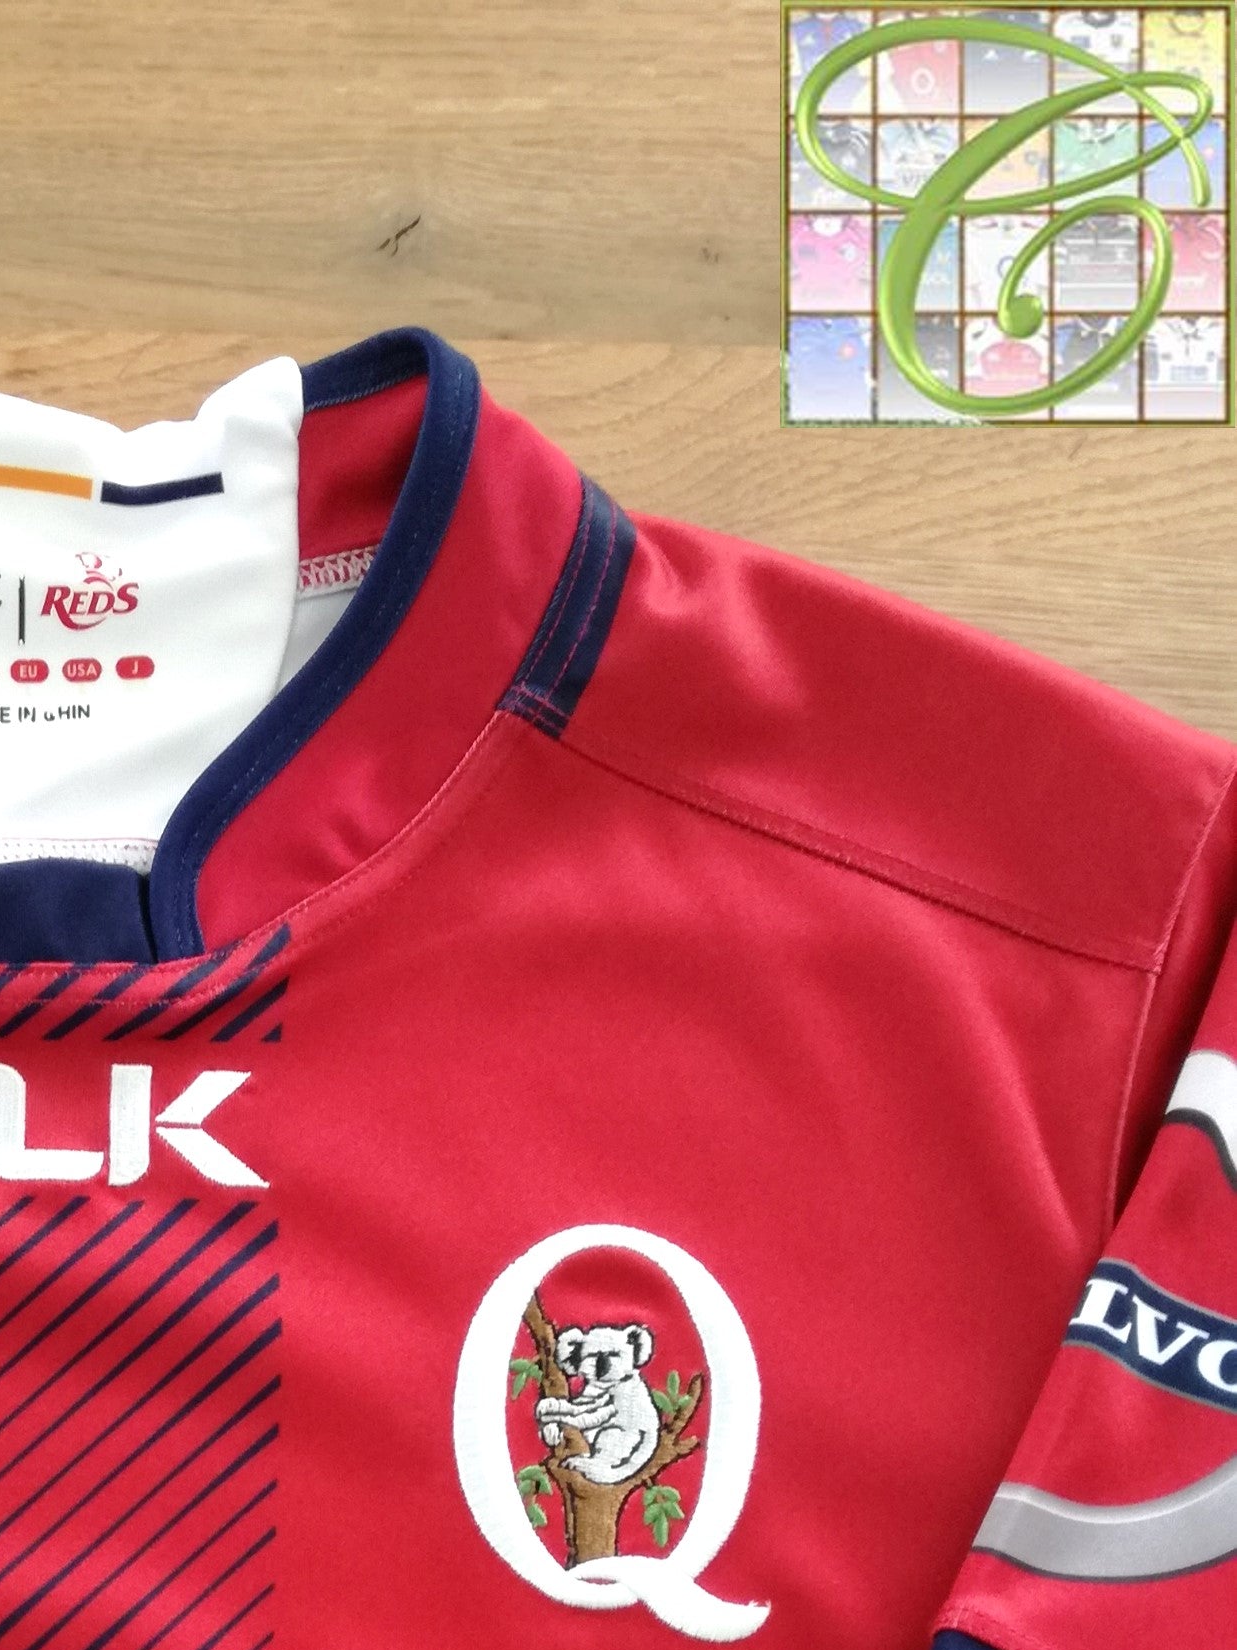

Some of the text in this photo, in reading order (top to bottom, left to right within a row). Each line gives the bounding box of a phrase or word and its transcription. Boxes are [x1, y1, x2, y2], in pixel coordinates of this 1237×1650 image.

[40, 582, 140, 631] REDS
[19, 664, 38, 678] EU
[67, 662, 98, 677] USA
[453, 1223, 772, 1643] Q
